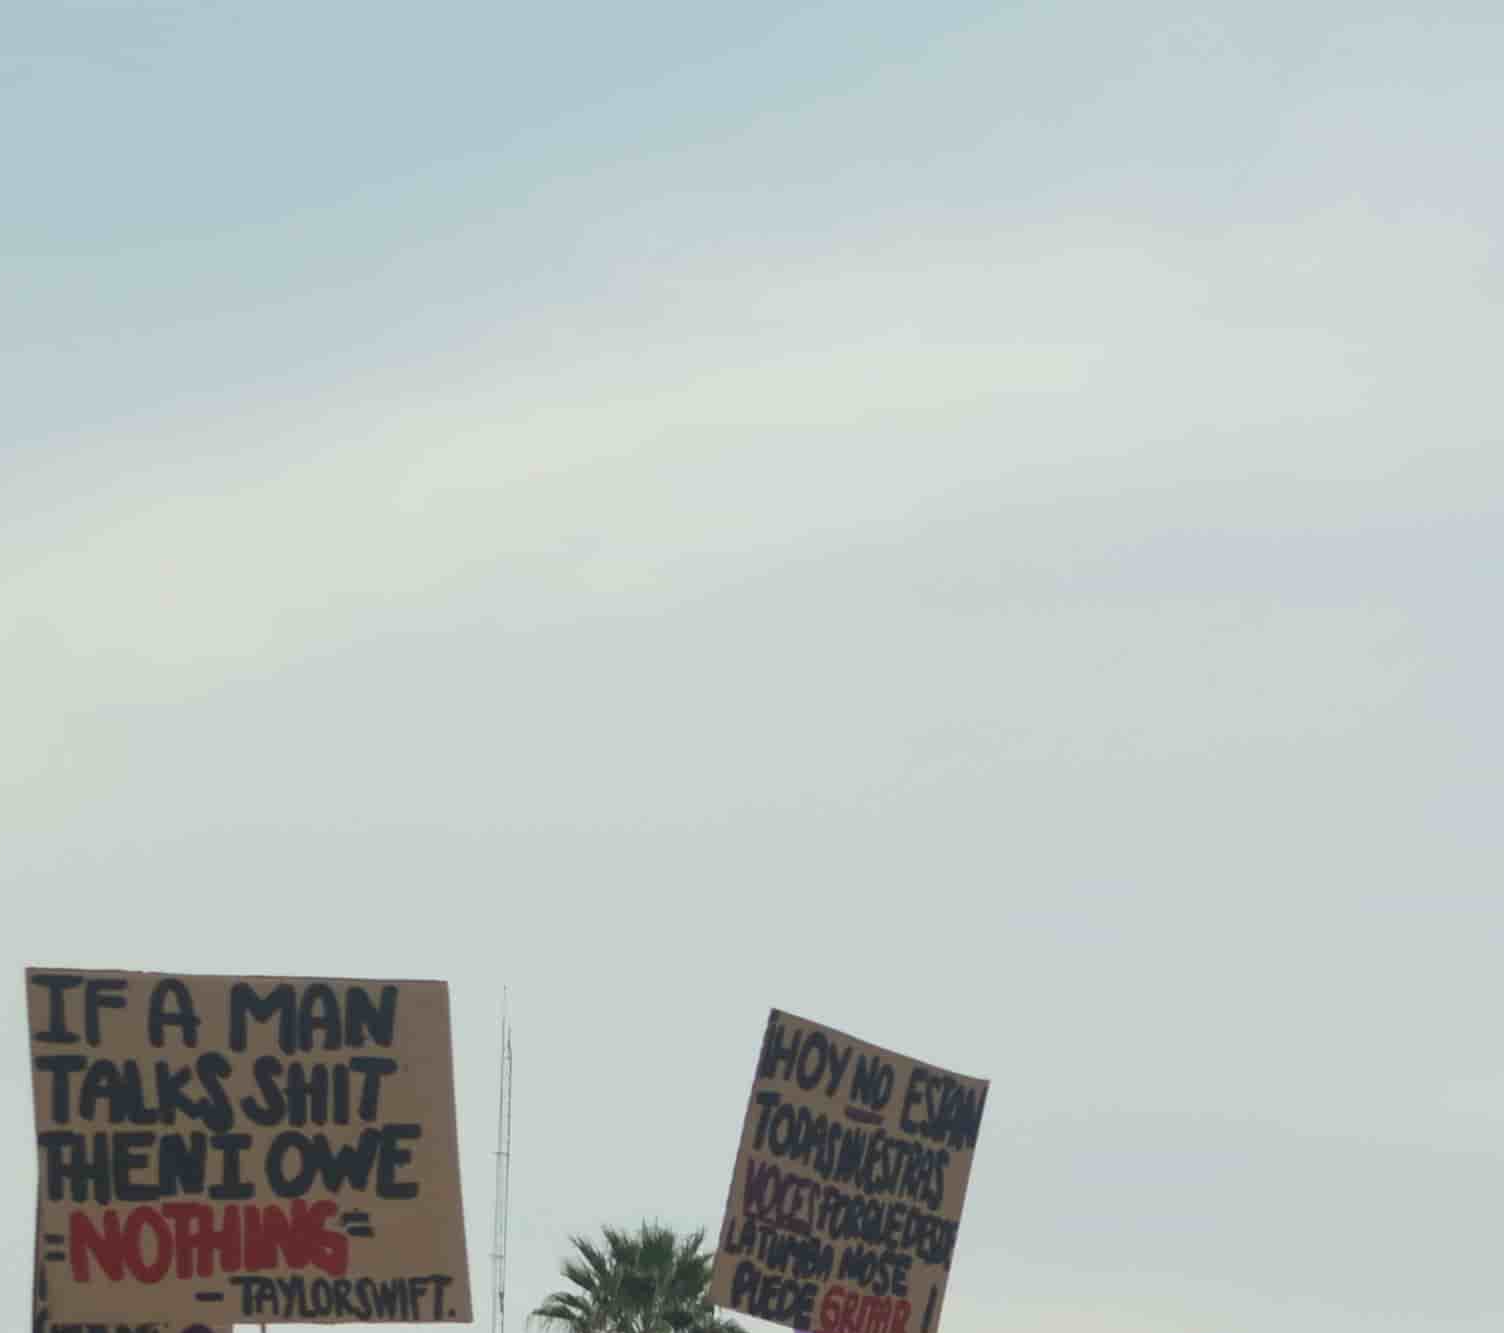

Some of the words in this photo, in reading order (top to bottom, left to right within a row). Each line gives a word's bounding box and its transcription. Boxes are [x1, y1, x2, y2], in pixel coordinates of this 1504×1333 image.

[31, 974, 127, 1046] IF
[148, 978, 200, 1048] A
[230, 983, 398, 1054] MAN
[35, 1052, 233, 1132] TALKS
[241, 1055, 397, 1126] SHIT
[850, 1055, 894, 1110] NO
[38, 1131, 207, 1205] THEN
[209, 1132, 253, 1199] I
[265, 1124, 421, 1199] OWE
